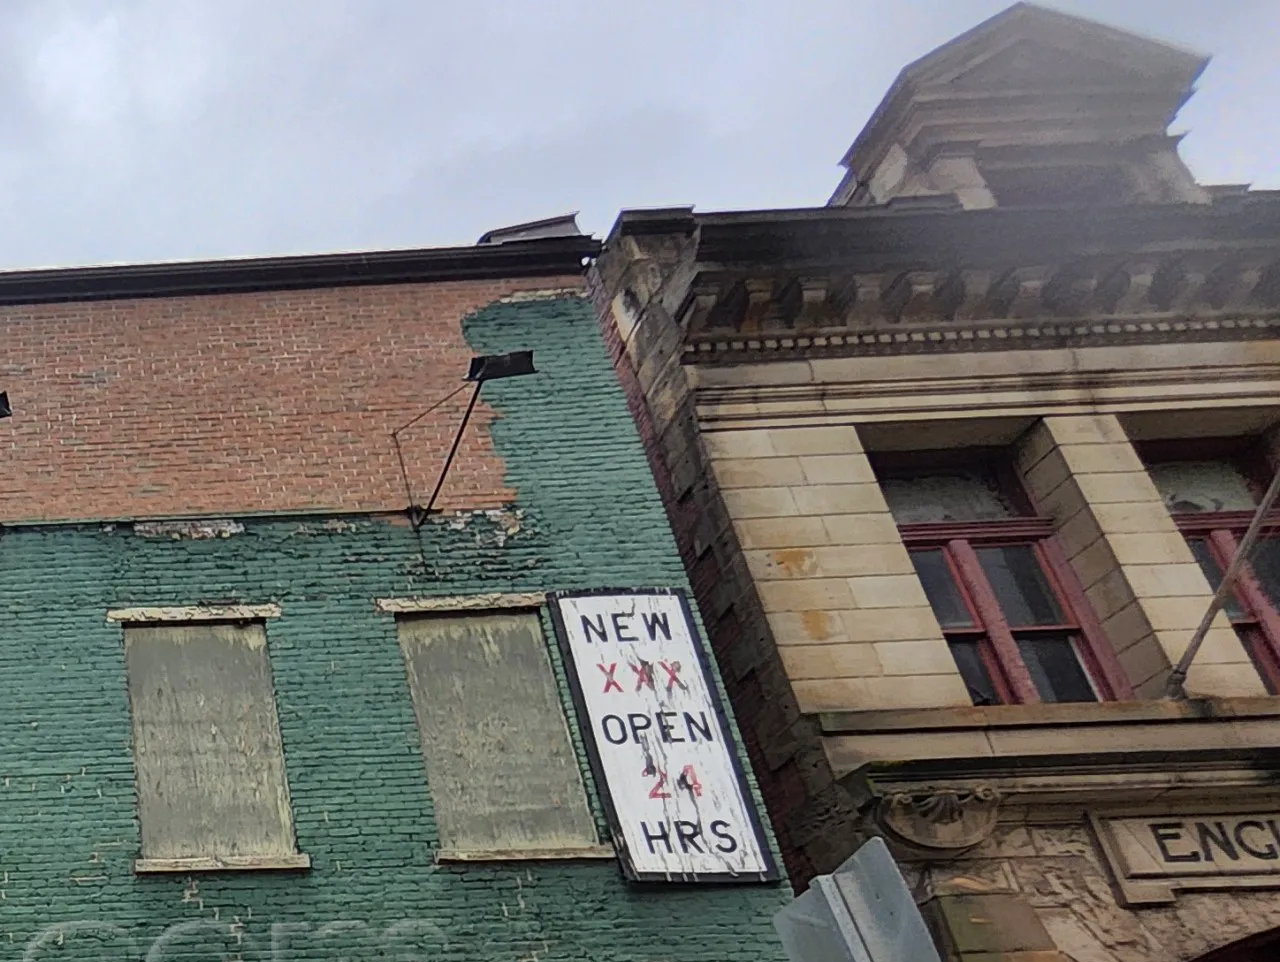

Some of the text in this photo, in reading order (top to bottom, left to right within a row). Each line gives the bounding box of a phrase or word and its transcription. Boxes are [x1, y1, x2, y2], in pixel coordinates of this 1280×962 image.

[580, 611, 673, 643] NEW
[597, 661, 690, 693] XXX
[601, 710, 714, 745] OPEN
[640, 820, 738, 855] HRS
